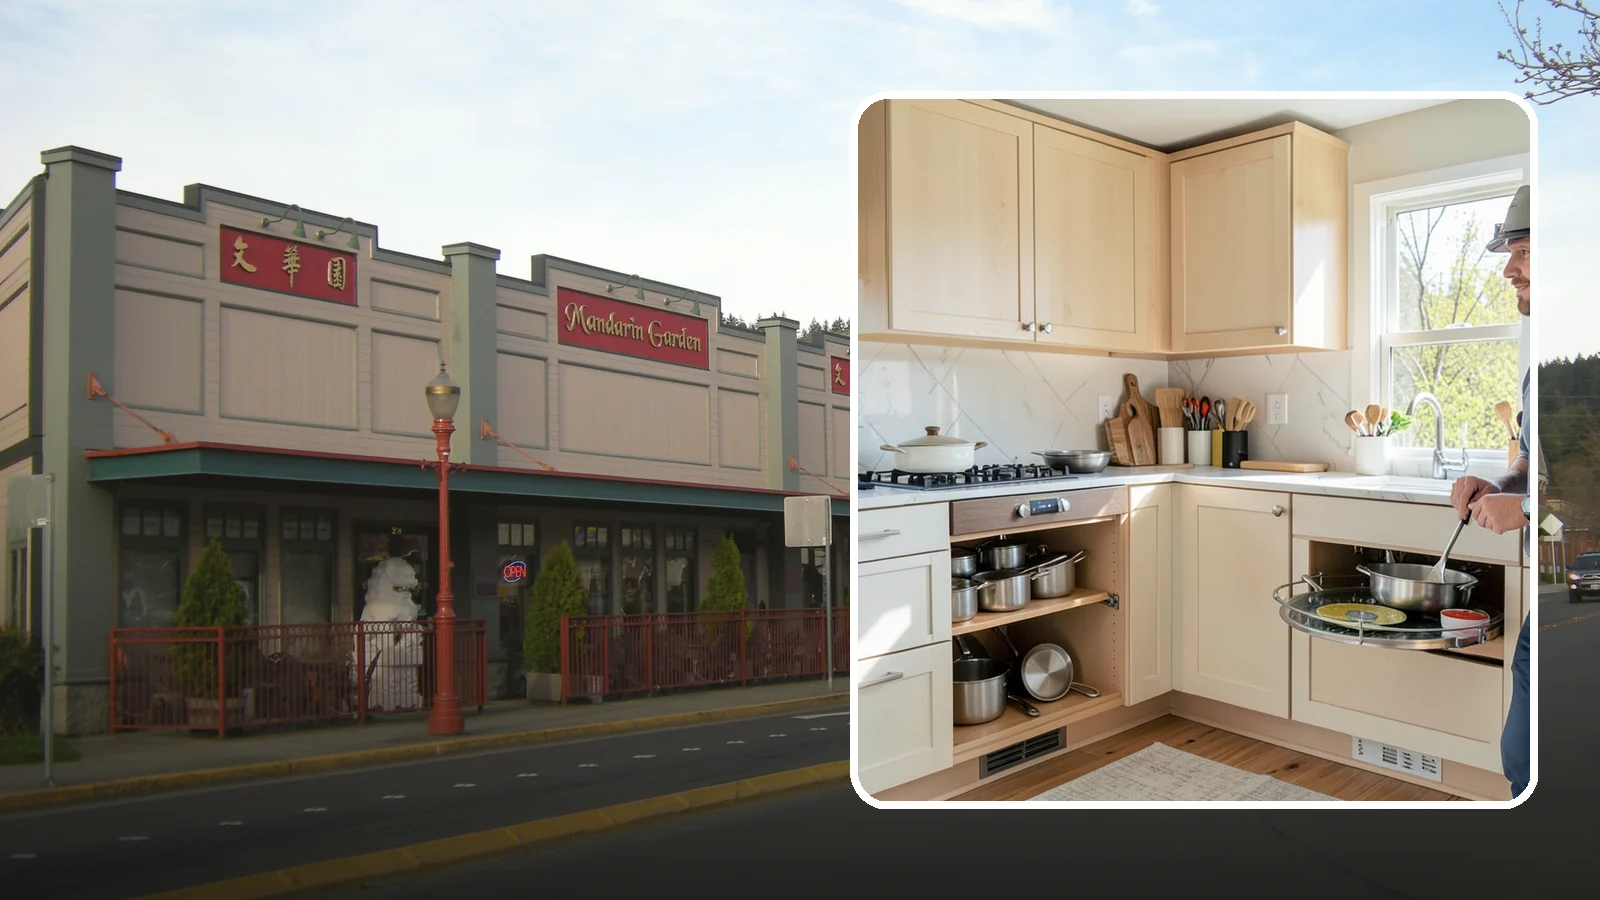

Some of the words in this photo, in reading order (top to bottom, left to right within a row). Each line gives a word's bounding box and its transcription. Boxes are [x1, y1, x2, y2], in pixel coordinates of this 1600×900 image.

[230, 235, 347, 291] 文華園
[564, 302, 644, 341] Mandarin
[647, 320, 702, 352] Garden
[503, 565, 527, 578] OPEN
